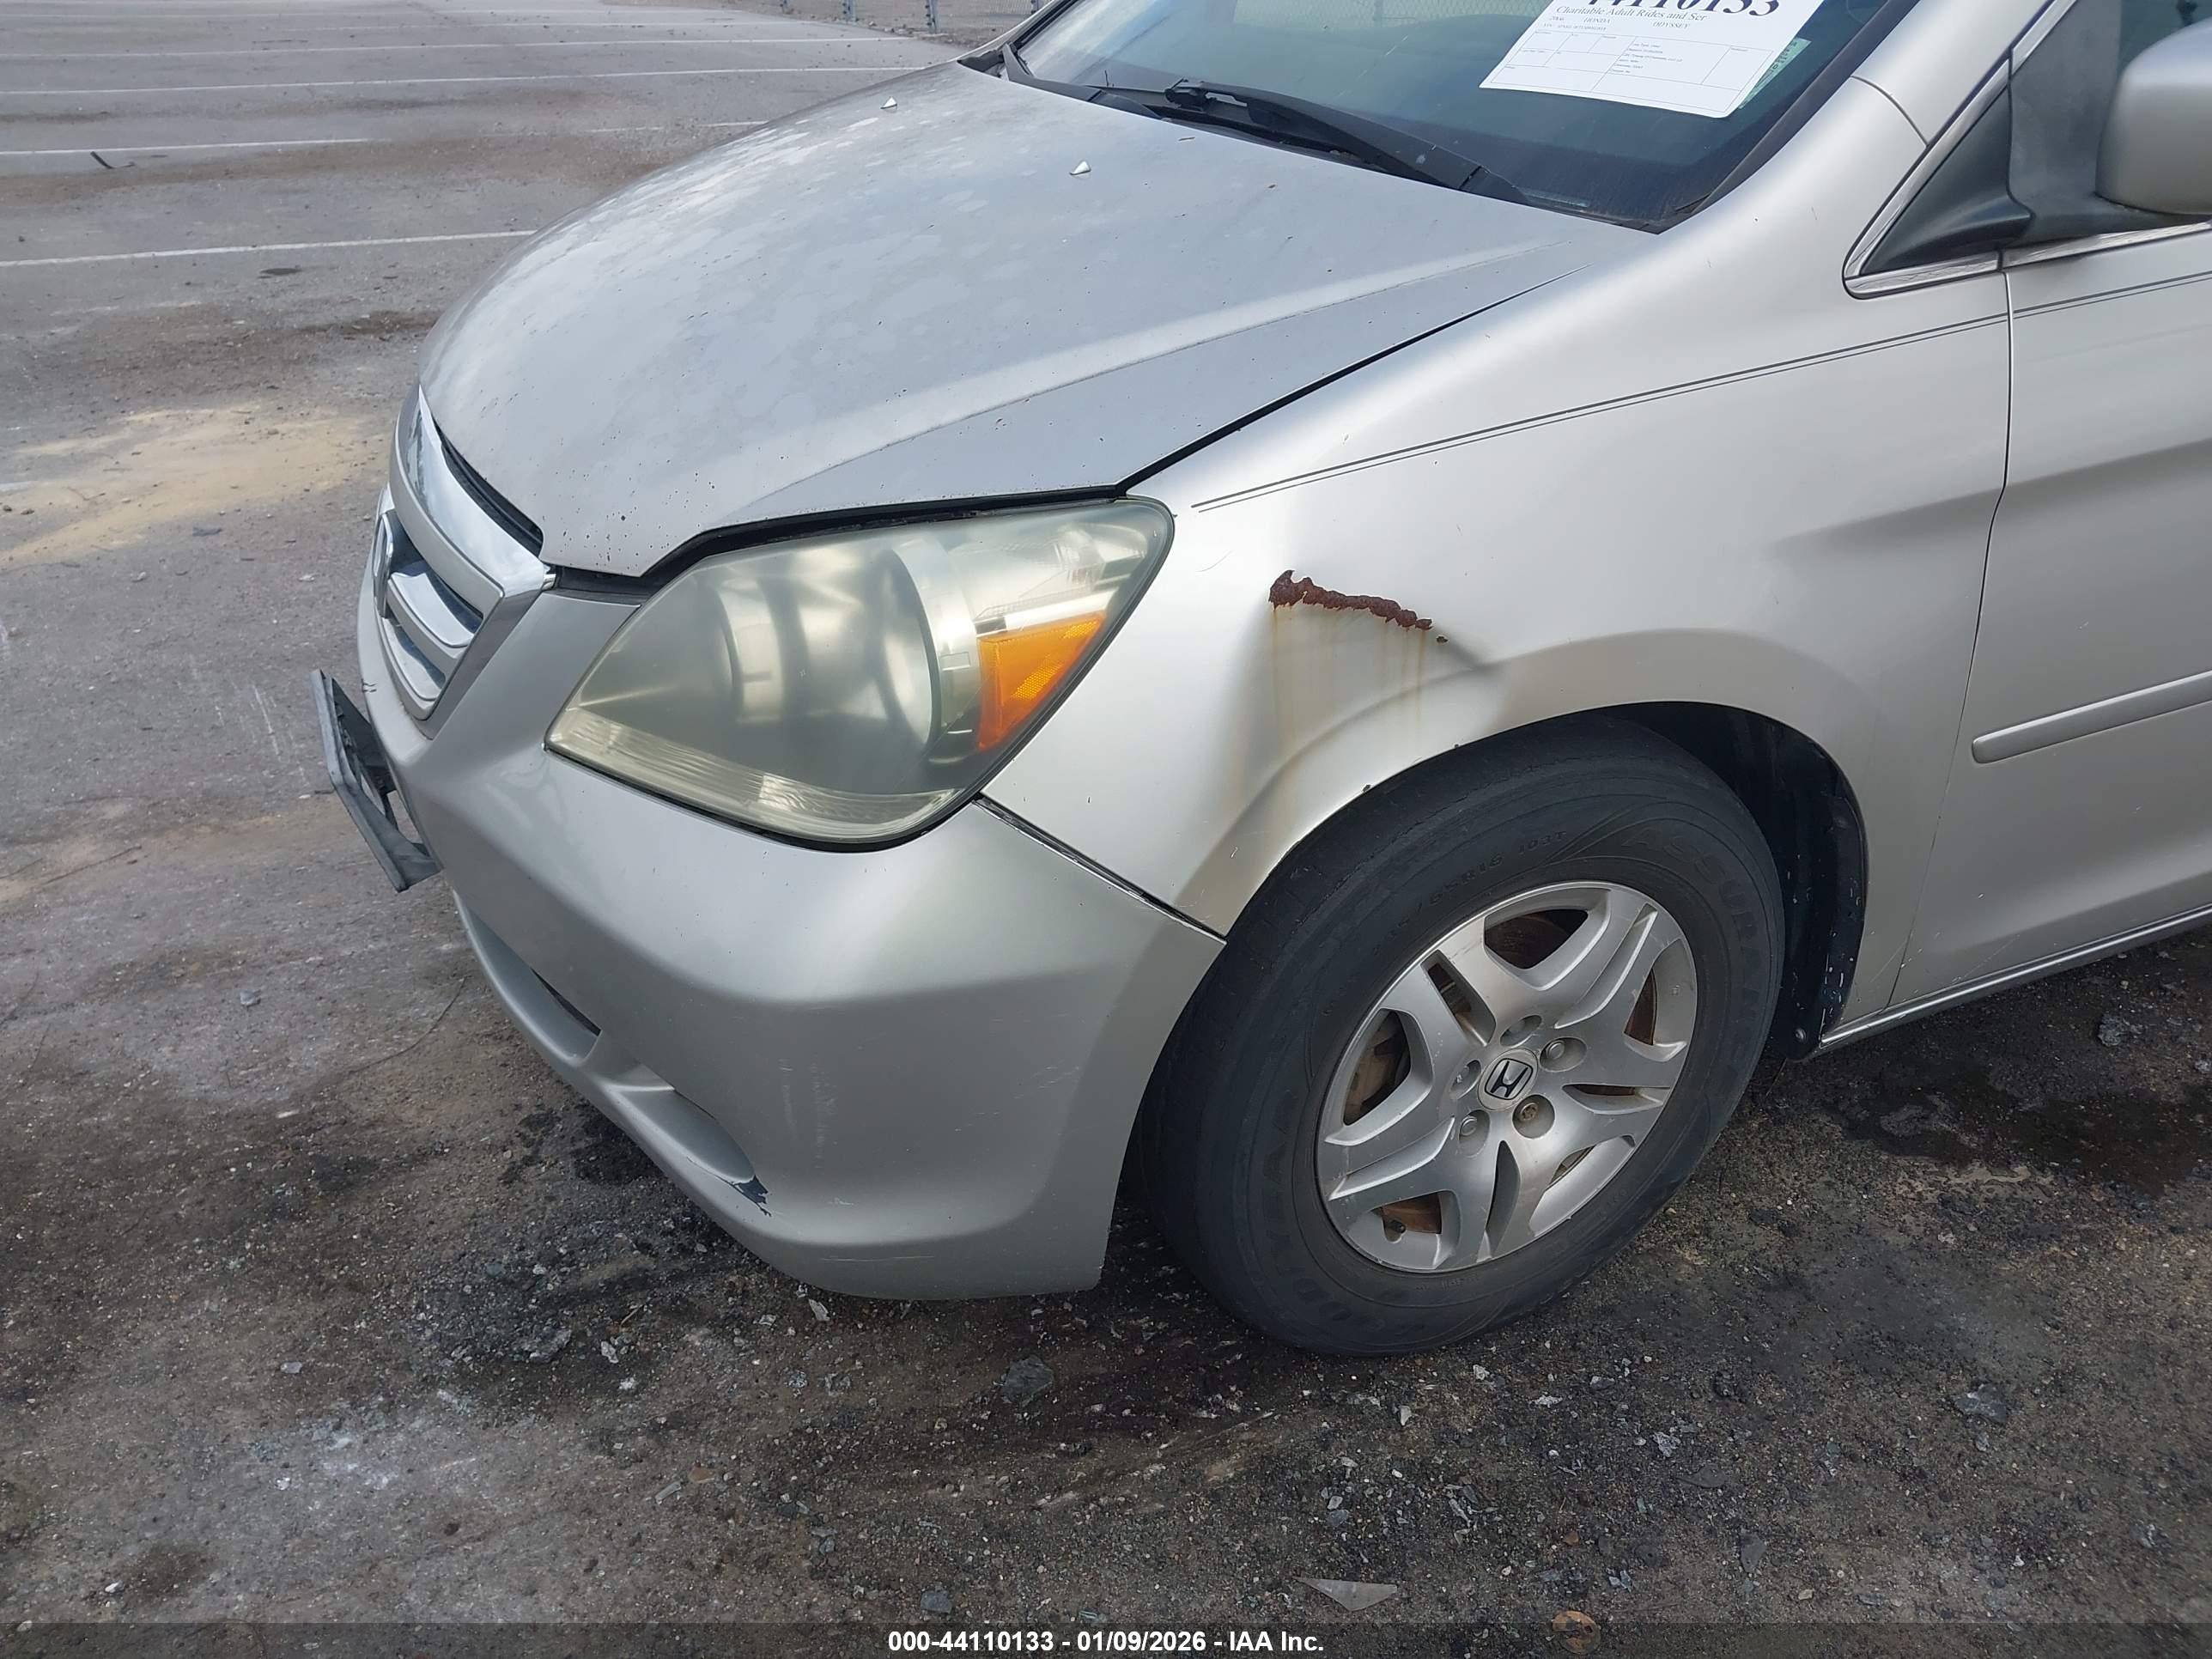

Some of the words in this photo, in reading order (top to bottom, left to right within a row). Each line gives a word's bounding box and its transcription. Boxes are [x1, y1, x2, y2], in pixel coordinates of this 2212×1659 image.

[1555, 6, 1606, 15] Charitable
[1606, 8, 1635, 16] Adult
[1636, 9, 1664, 18] Rides
[1689, 12, 1708, 21] Ser
